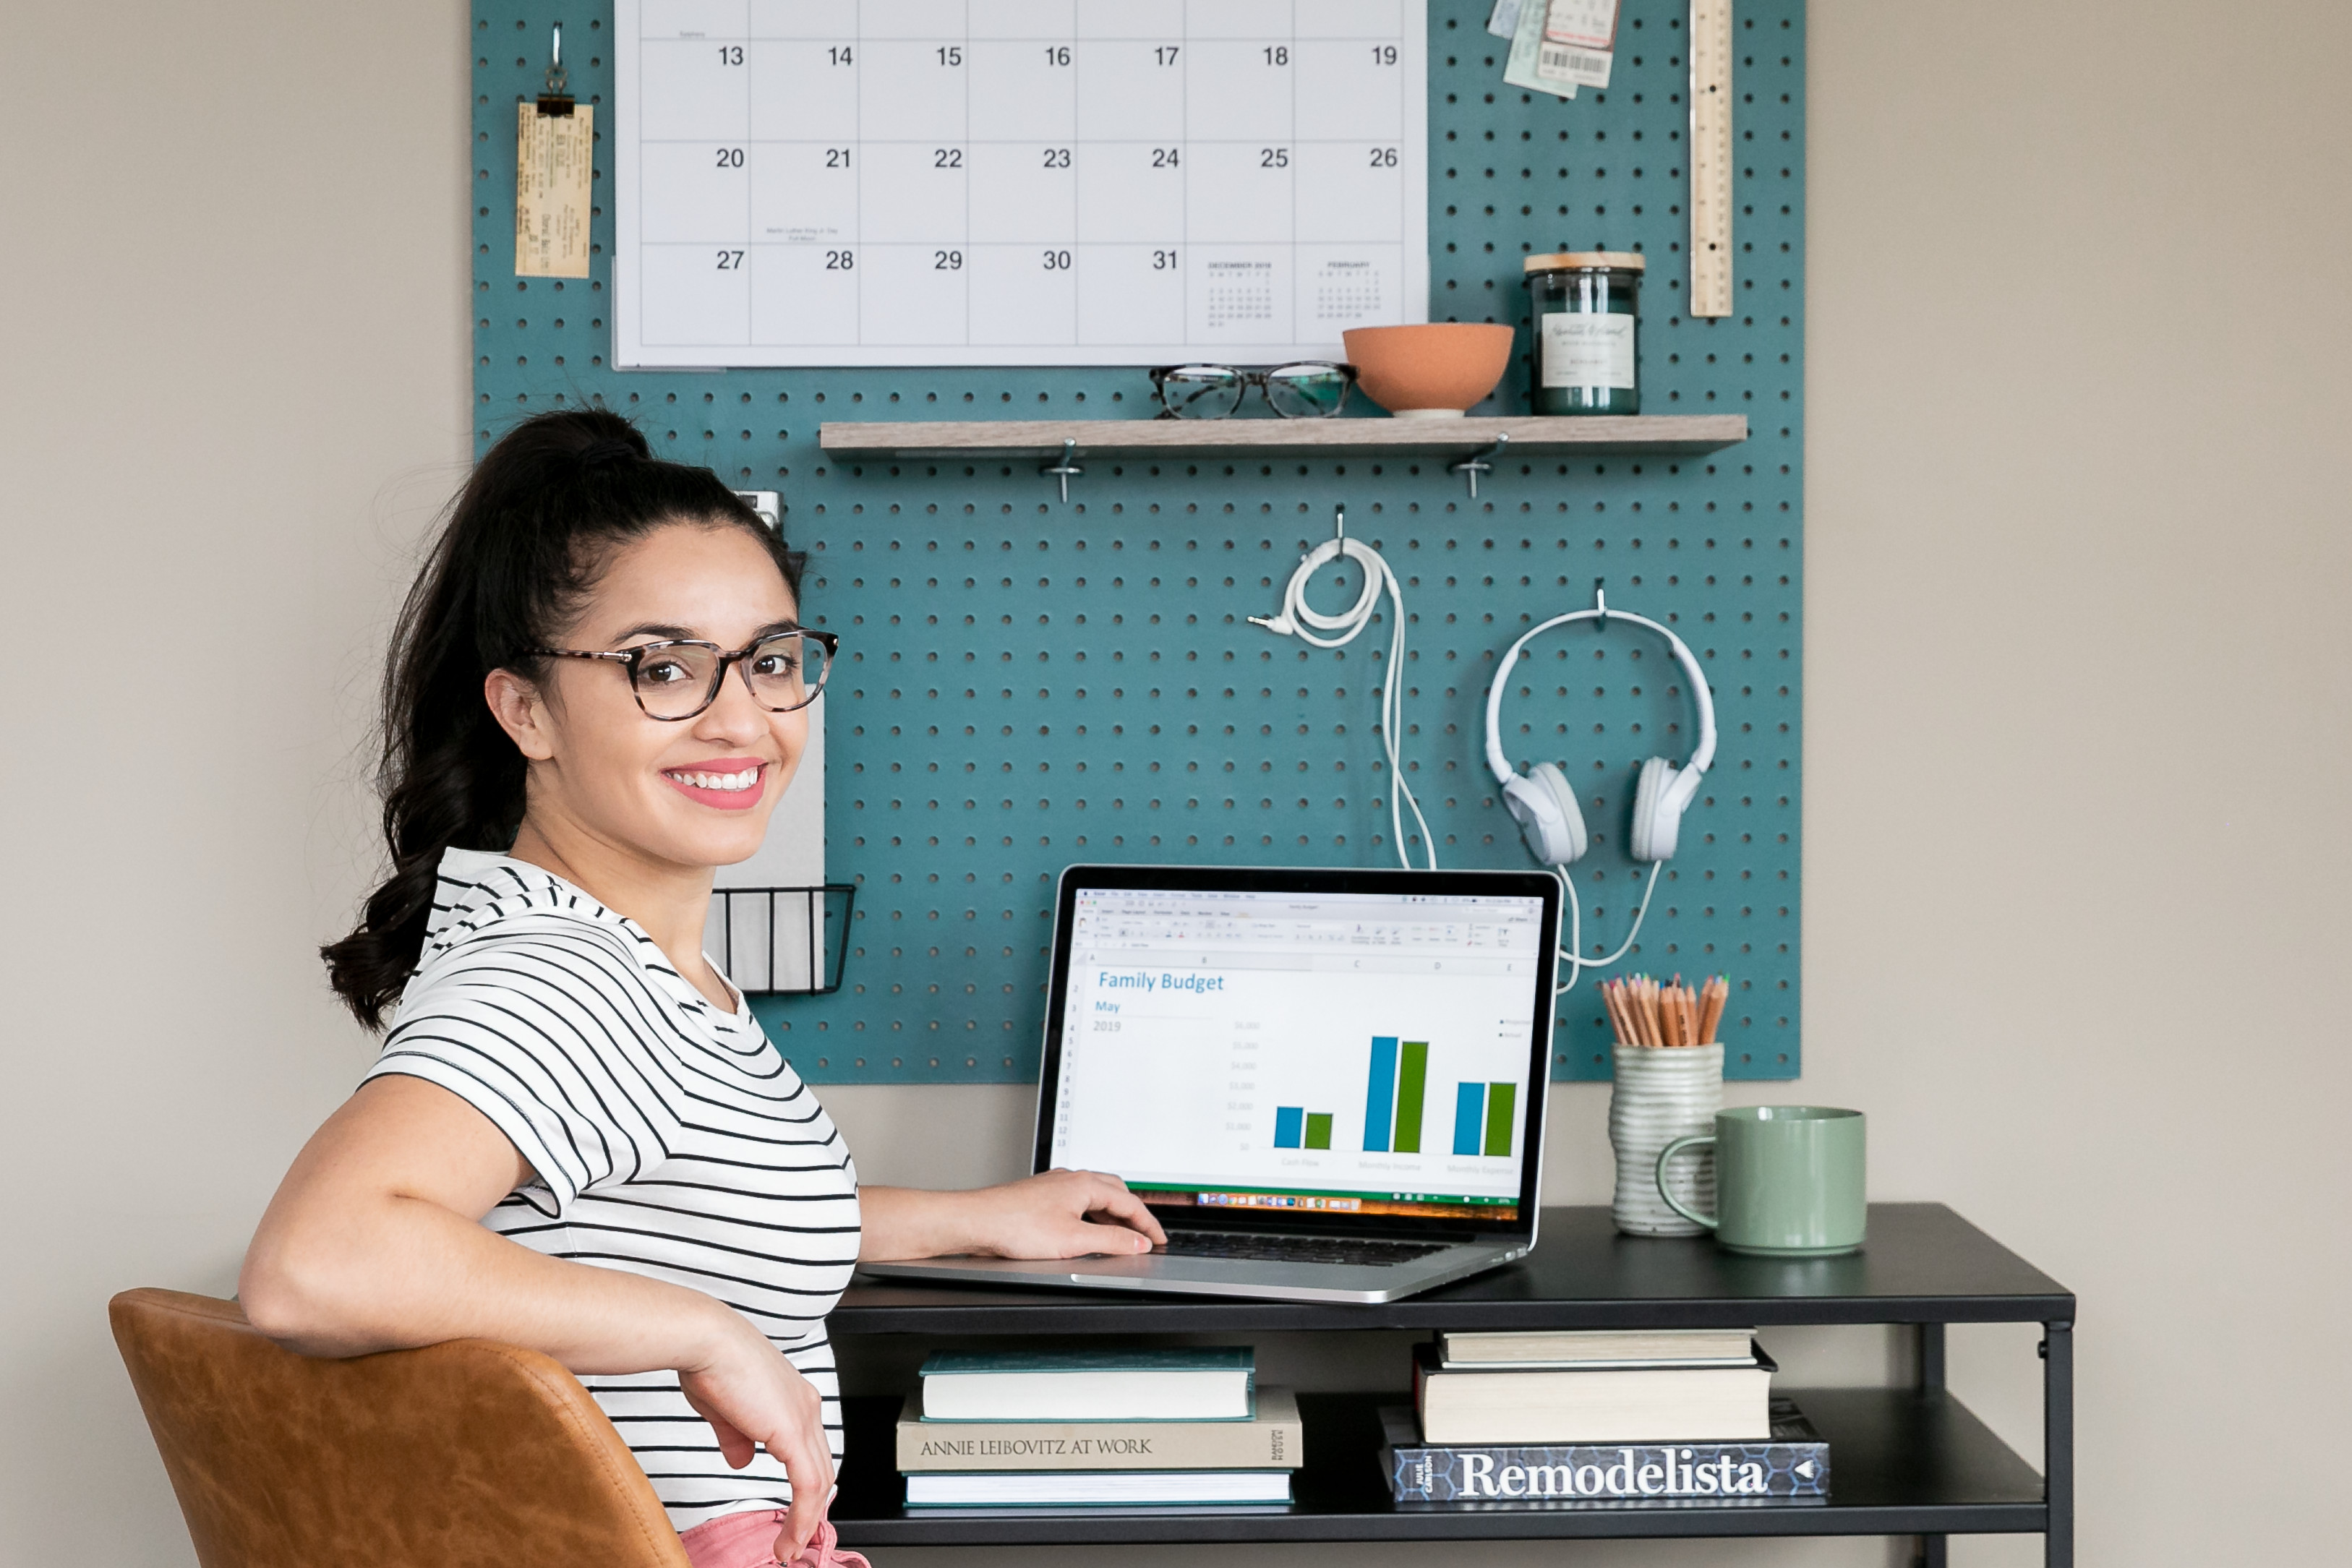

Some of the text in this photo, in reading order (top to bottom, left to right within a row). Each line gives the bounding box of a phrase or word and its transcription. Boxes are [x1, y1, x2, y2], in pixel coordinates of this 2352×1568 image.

[719, 46, 744, 66] 13
[828, 46, 853, 66] 14
[937, 46, 962, 67] 15
[1045, 46, 1071, 67] 16
[1155, 46, 1179, 66] 17
[1264, 46, 1288, 66] 18
[1372, 46, 1398, 65] 19
[717, 148, 745, 168] 20
[826, 148, 850, 168] 21
[935, 149, 962, 168] 22
[1043, 148, 1071, 168] 23
[1153, 148, 1179, 168] 24
[1261, 148, 1288, 168] 25
[1370, 147, 1398, 168] 26
[717, 250, 745, 270] 27
[826, 250, 854, 270] 28
[935, 250, 962, 270] 29
[1043, 250, 1072, 270] 30
[1153, 250, 1176, 270] 31
[1098, 972, 1224, 993] Family Budget
[1095, 1000, 1121, 1015] May
[1092, 1020, 1121, 1032] 2019
[1358, 1160, 1390, 1171] Monthly
[1447, 1164, 1480, 1175] Monthly
[920, 1439, 1153, 1456] ANNIE LEIBOVITZ AT WORK
[1415, 1463, 1424, 1485] JULIE
[1424, 1455, 1433, 1494] CARLSON
[1458, 1448, 1769, 1497] Remodelista
